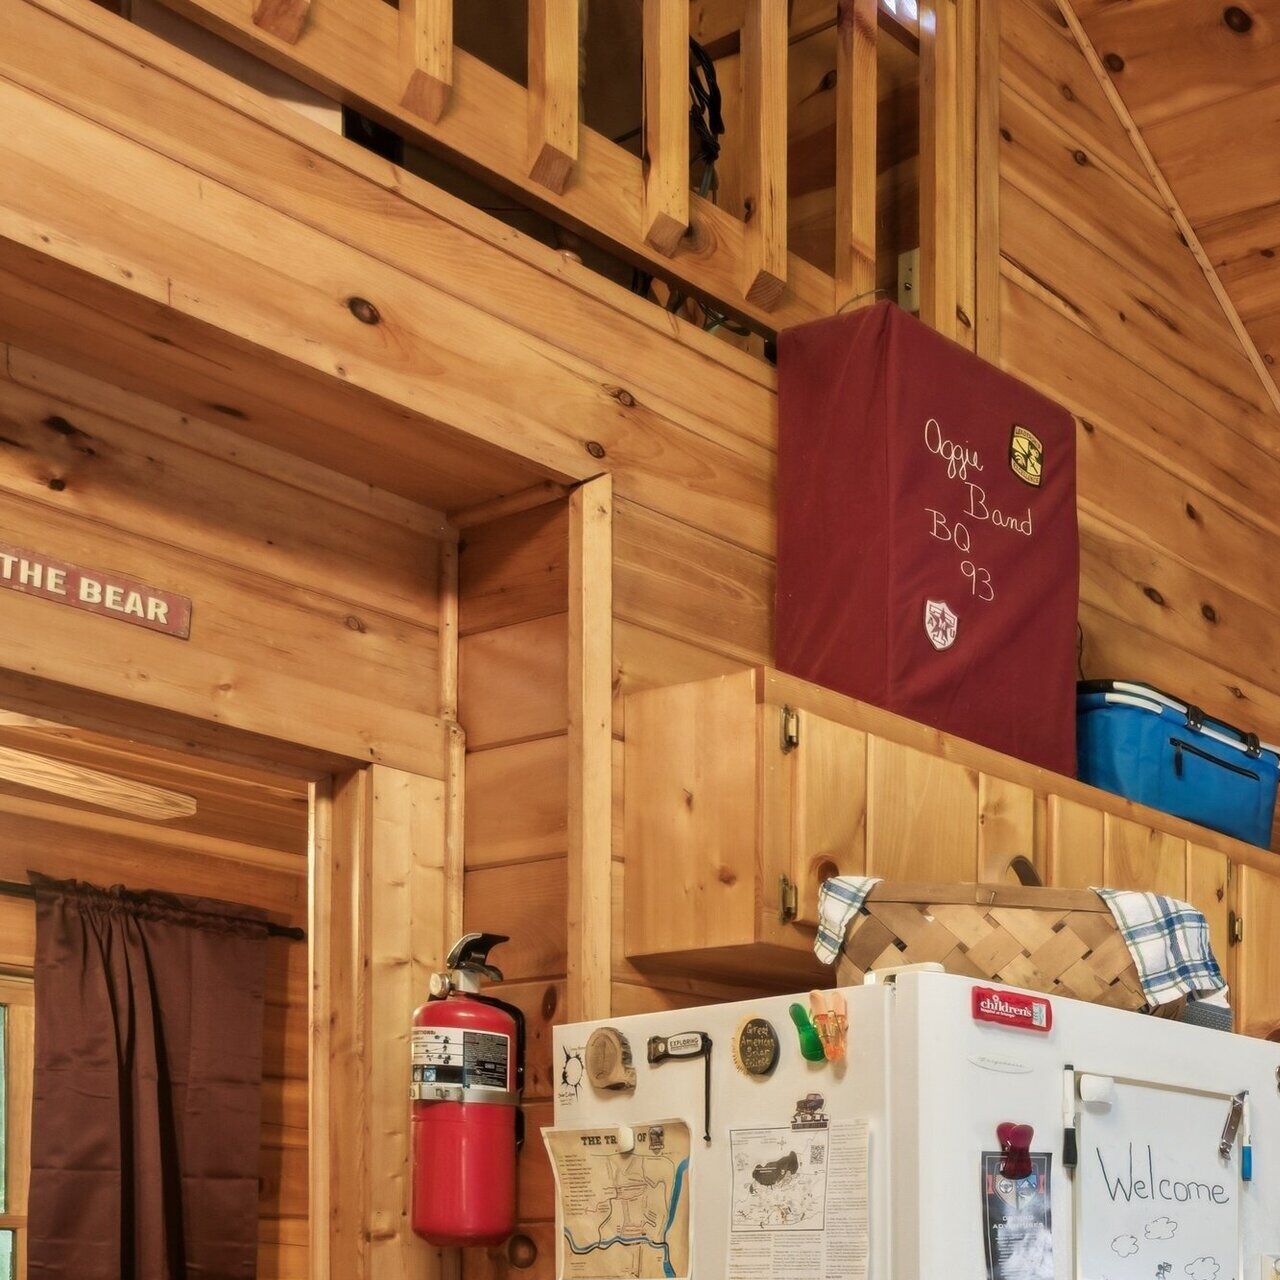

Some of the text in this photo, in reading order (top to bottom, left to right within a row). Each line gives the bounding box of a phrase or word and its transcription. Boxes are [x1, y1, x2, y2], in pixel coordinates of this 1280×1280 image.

[924, 508, 970, 553] BQ
[963, 482, 1033, 536] Band
[1, 553, 169, 625] THE BEAR
[960, 560, 994, 601] 93
[981, 994, 1032, 1017] children's
[670, 1036, 699, 1047] EXPLORING
[580, 1135, 602, 1146] THE
[637, 1132, 647, 1142] OF
[1096, 1141, 1230, 1205] Welcome
